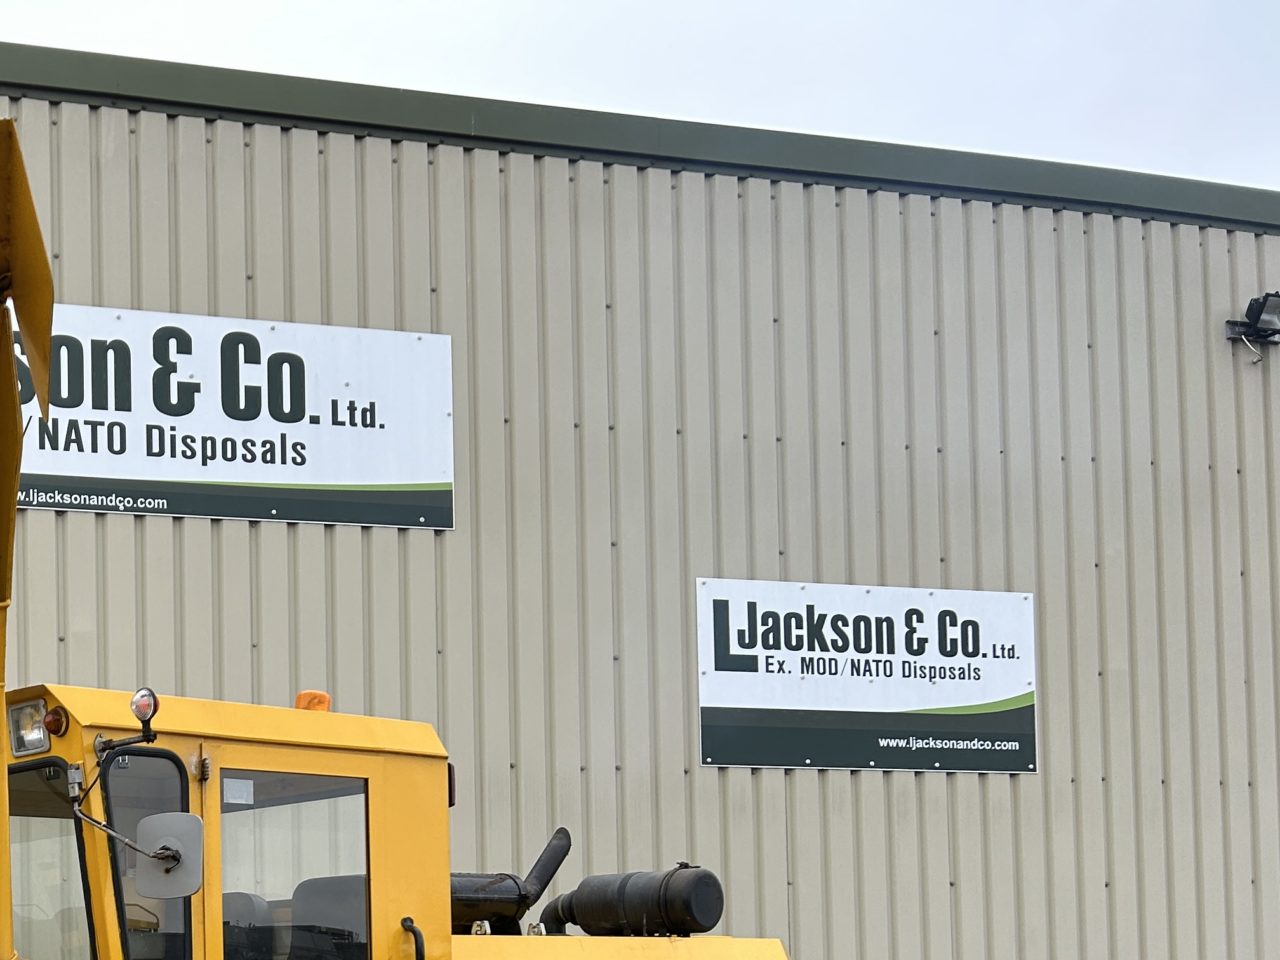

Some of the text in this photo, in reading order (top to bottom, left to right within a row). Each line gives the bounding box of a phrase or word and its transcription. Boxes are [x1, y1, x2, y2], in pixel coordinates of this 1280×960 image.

[151, 325, 201, 416] &
[219, 330, 321, 426] Co.
[331, 398, 386, 431] Ltd.
[22, 414, 308, 468] /NATO Disposals
[17, 488, 168, 510] w.ljacksonandco.com
[904, 607, 928, 657] &
[937, 609, 988, 659] Co.
[992, 643, 1021, 661] Ltd.
[765, 655, 982, 683] Ex. MOD/NATO Disposals
[878, 735, 1020, 751] www.ljacksonandco.com
